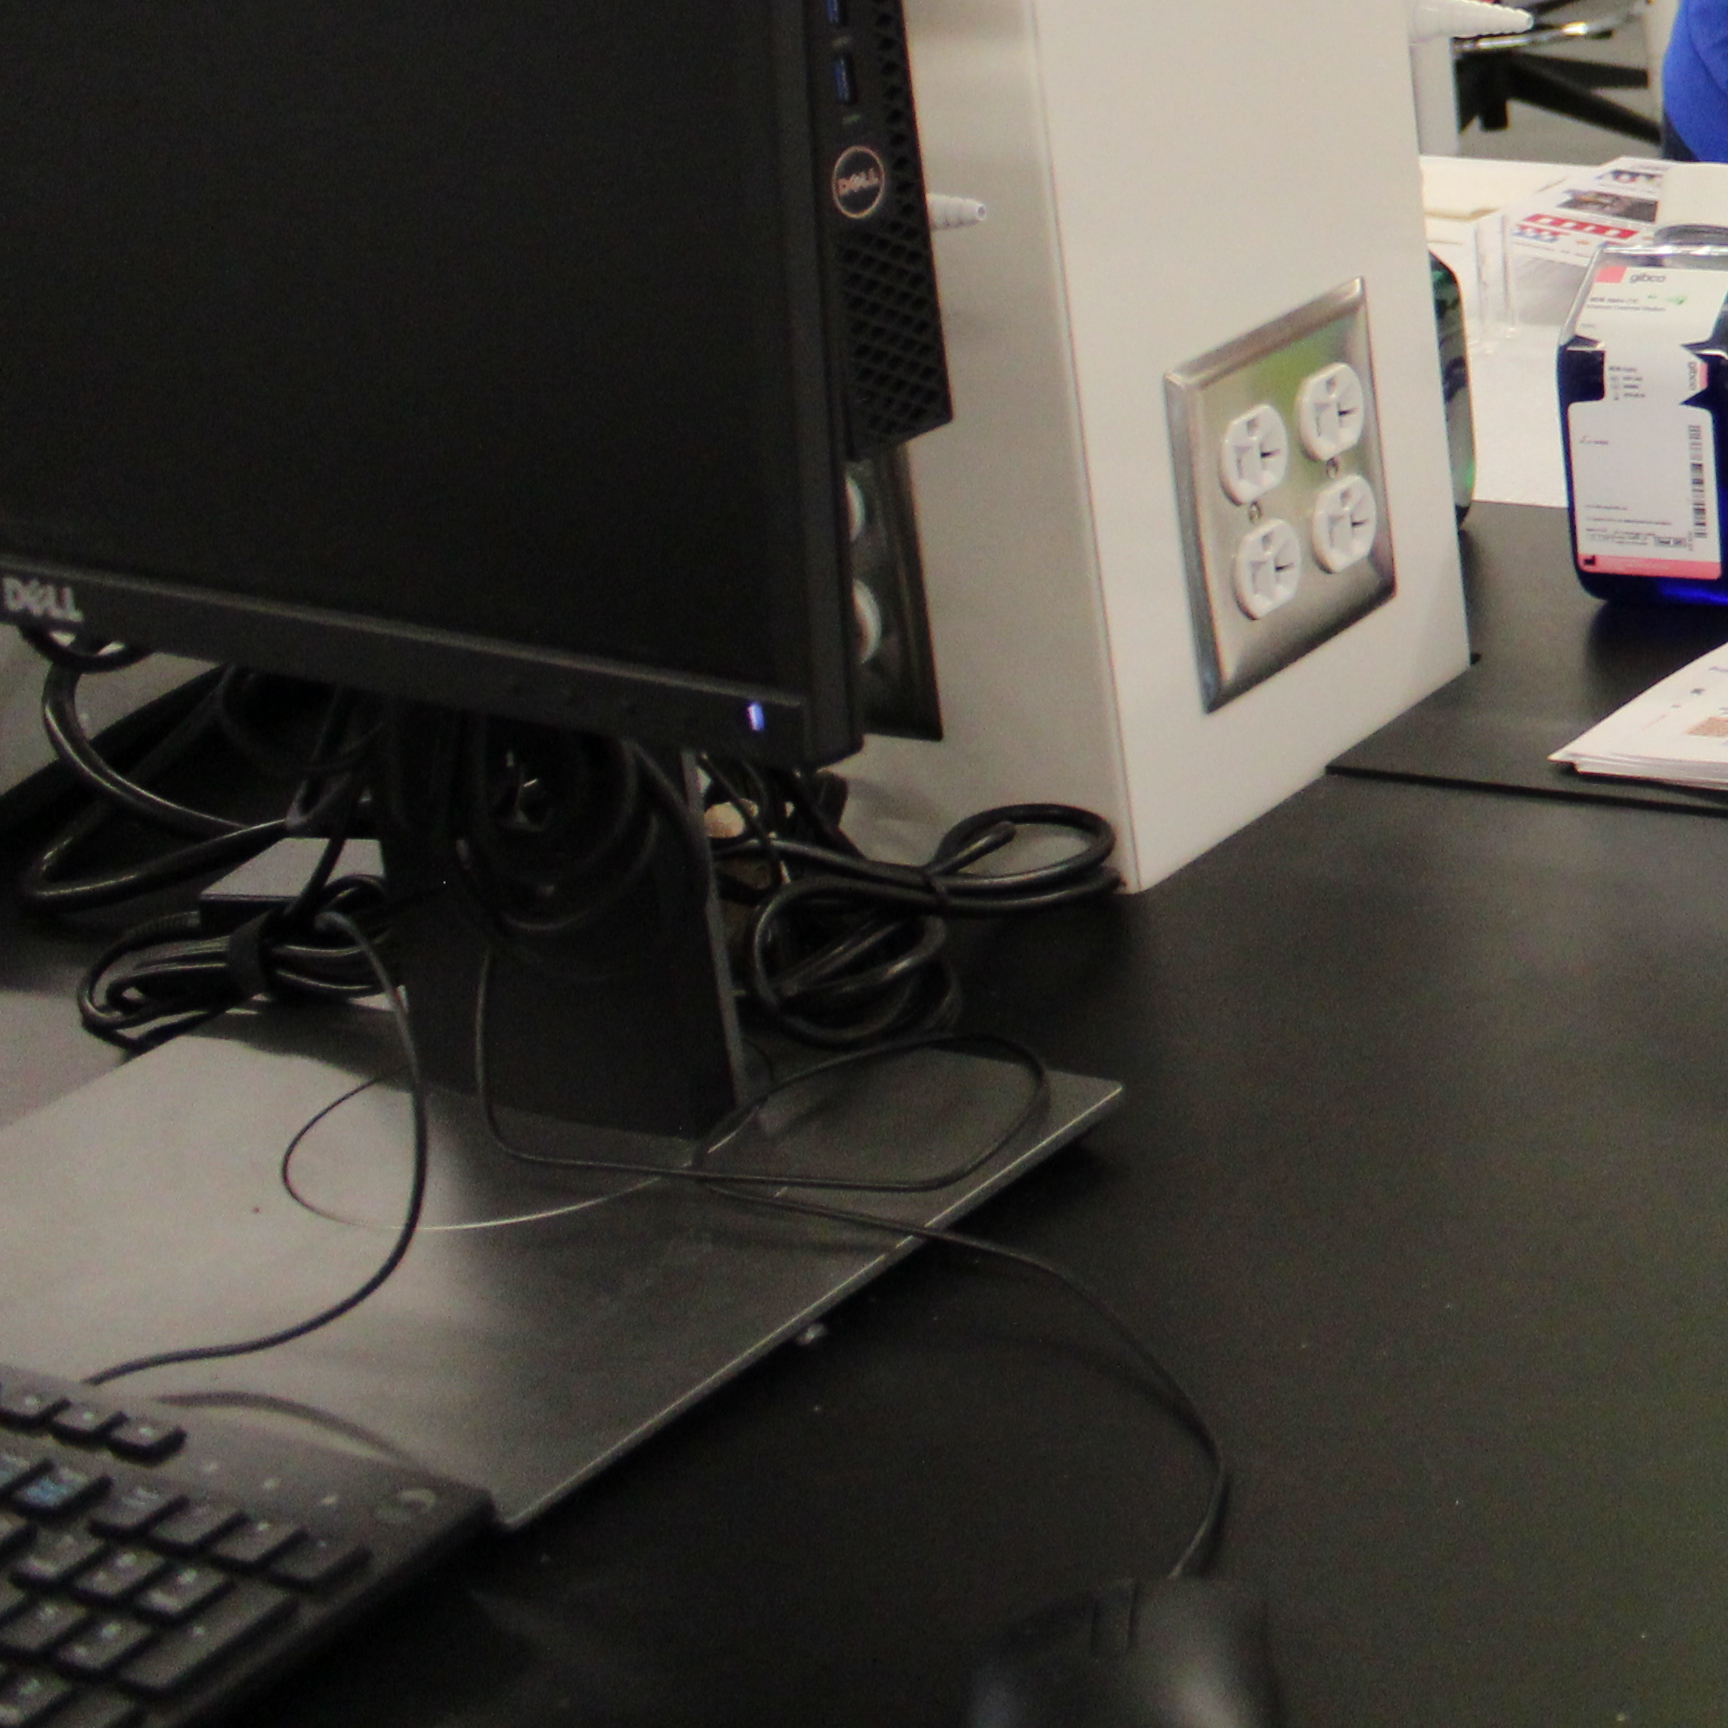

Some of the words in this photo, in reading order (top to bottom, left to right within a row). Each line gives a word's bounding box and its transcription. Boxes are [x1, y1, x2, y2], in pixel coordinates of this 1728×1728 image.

[835, 166, 879, 197] DELL
[1629, 273, 1667, 284] gibco
[1687, 361, 1696, 391] gibco
[3, 577, 84, 622] DELL
